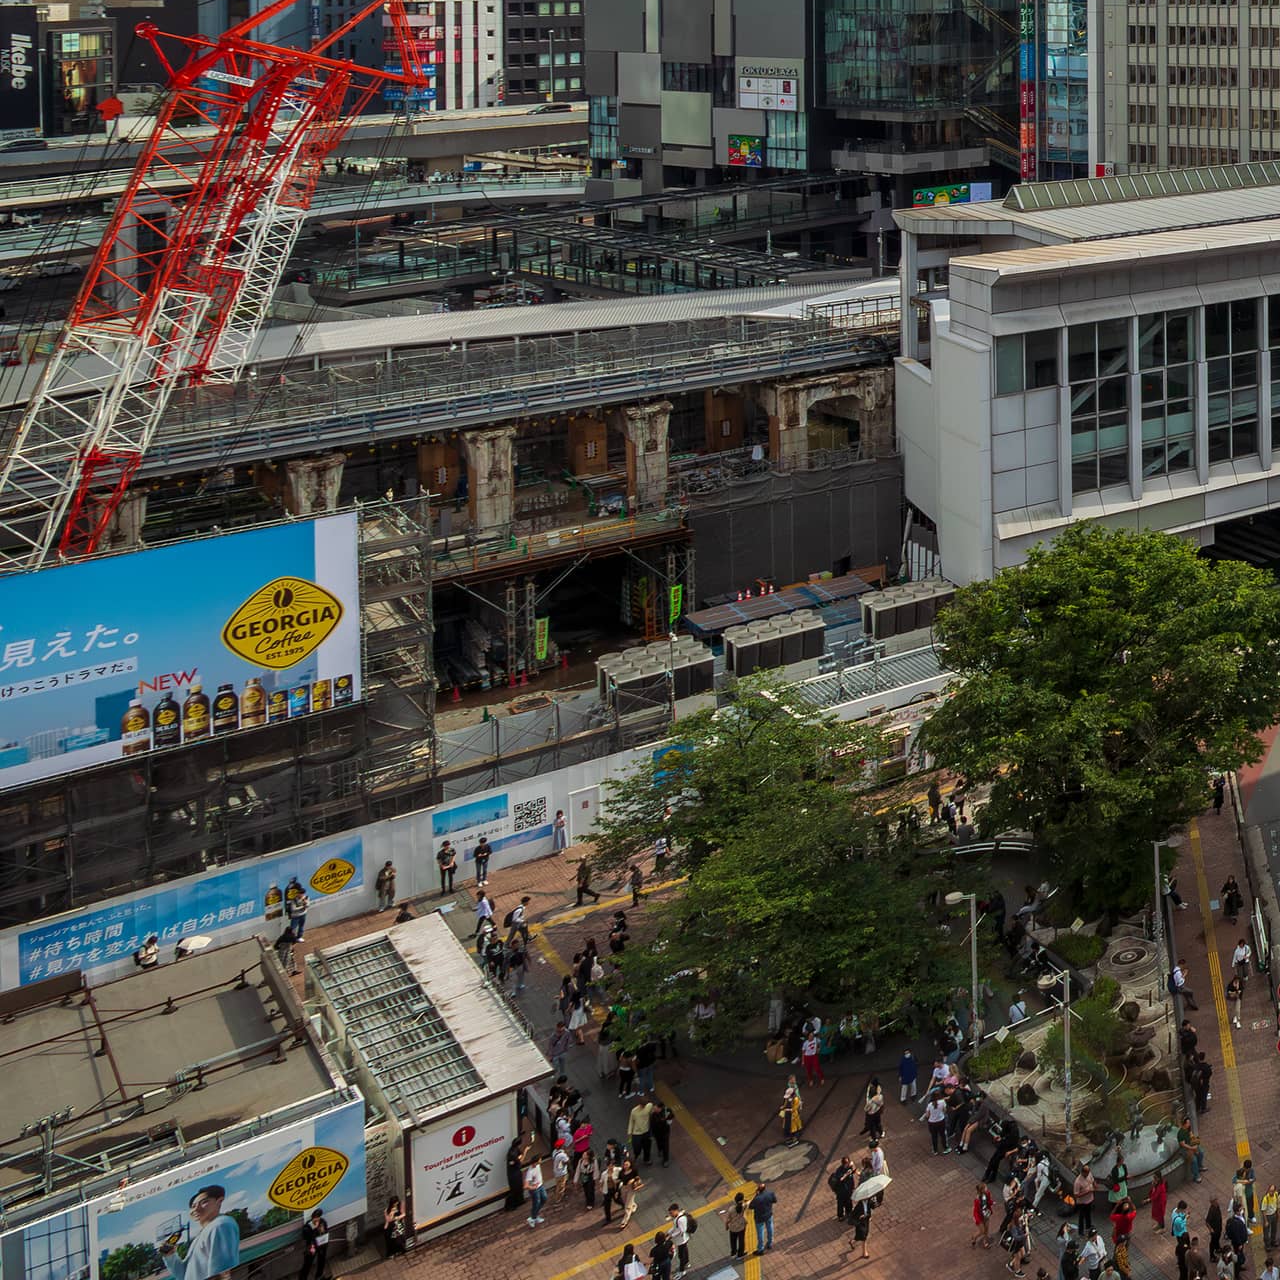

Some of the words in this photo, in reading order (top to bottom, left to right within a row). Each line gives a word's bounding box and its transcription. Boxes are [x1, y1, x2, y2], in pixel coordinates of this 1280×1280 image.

[11, 33, 33, 90] Ikebe
[231, 605, 336, 641] GEORGIA
[254, 629, 314, 655] Coffee
[139, 669, 198, 694] NEW
[313, 868, 355, 884] GEORGIA
[424, 1155, 453, 1171] Tourist
[455, 1135, 505, 1160] Information
[274, 1164, 344, 1197] GEORGIA
[289, 1181, 330, 1203] Coffee
